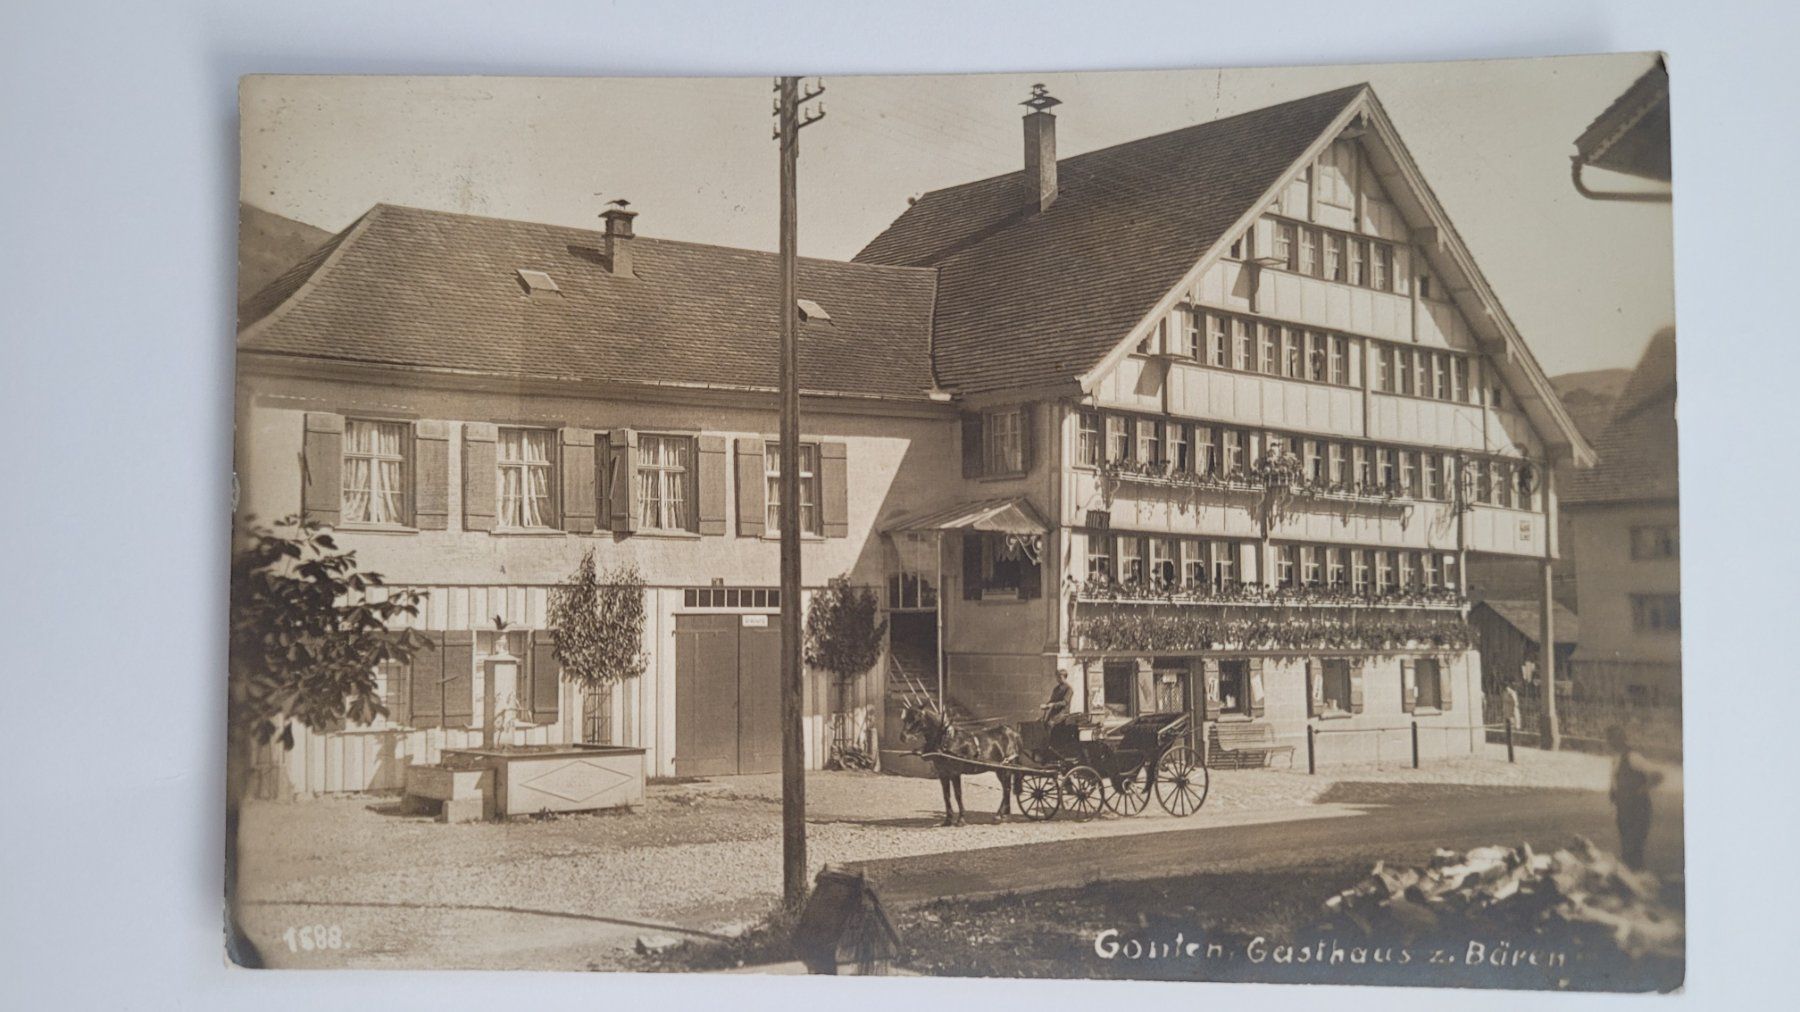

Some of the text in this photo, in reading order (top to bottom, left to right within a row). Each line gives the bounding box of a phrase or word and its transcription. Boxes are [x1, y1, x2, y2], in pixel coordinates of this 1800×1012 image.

[1247, 937, 1411, 965] Gasthaus
[1429, 949, 1455, 964] z.
[1465, 940, 1565, 967] Bären
